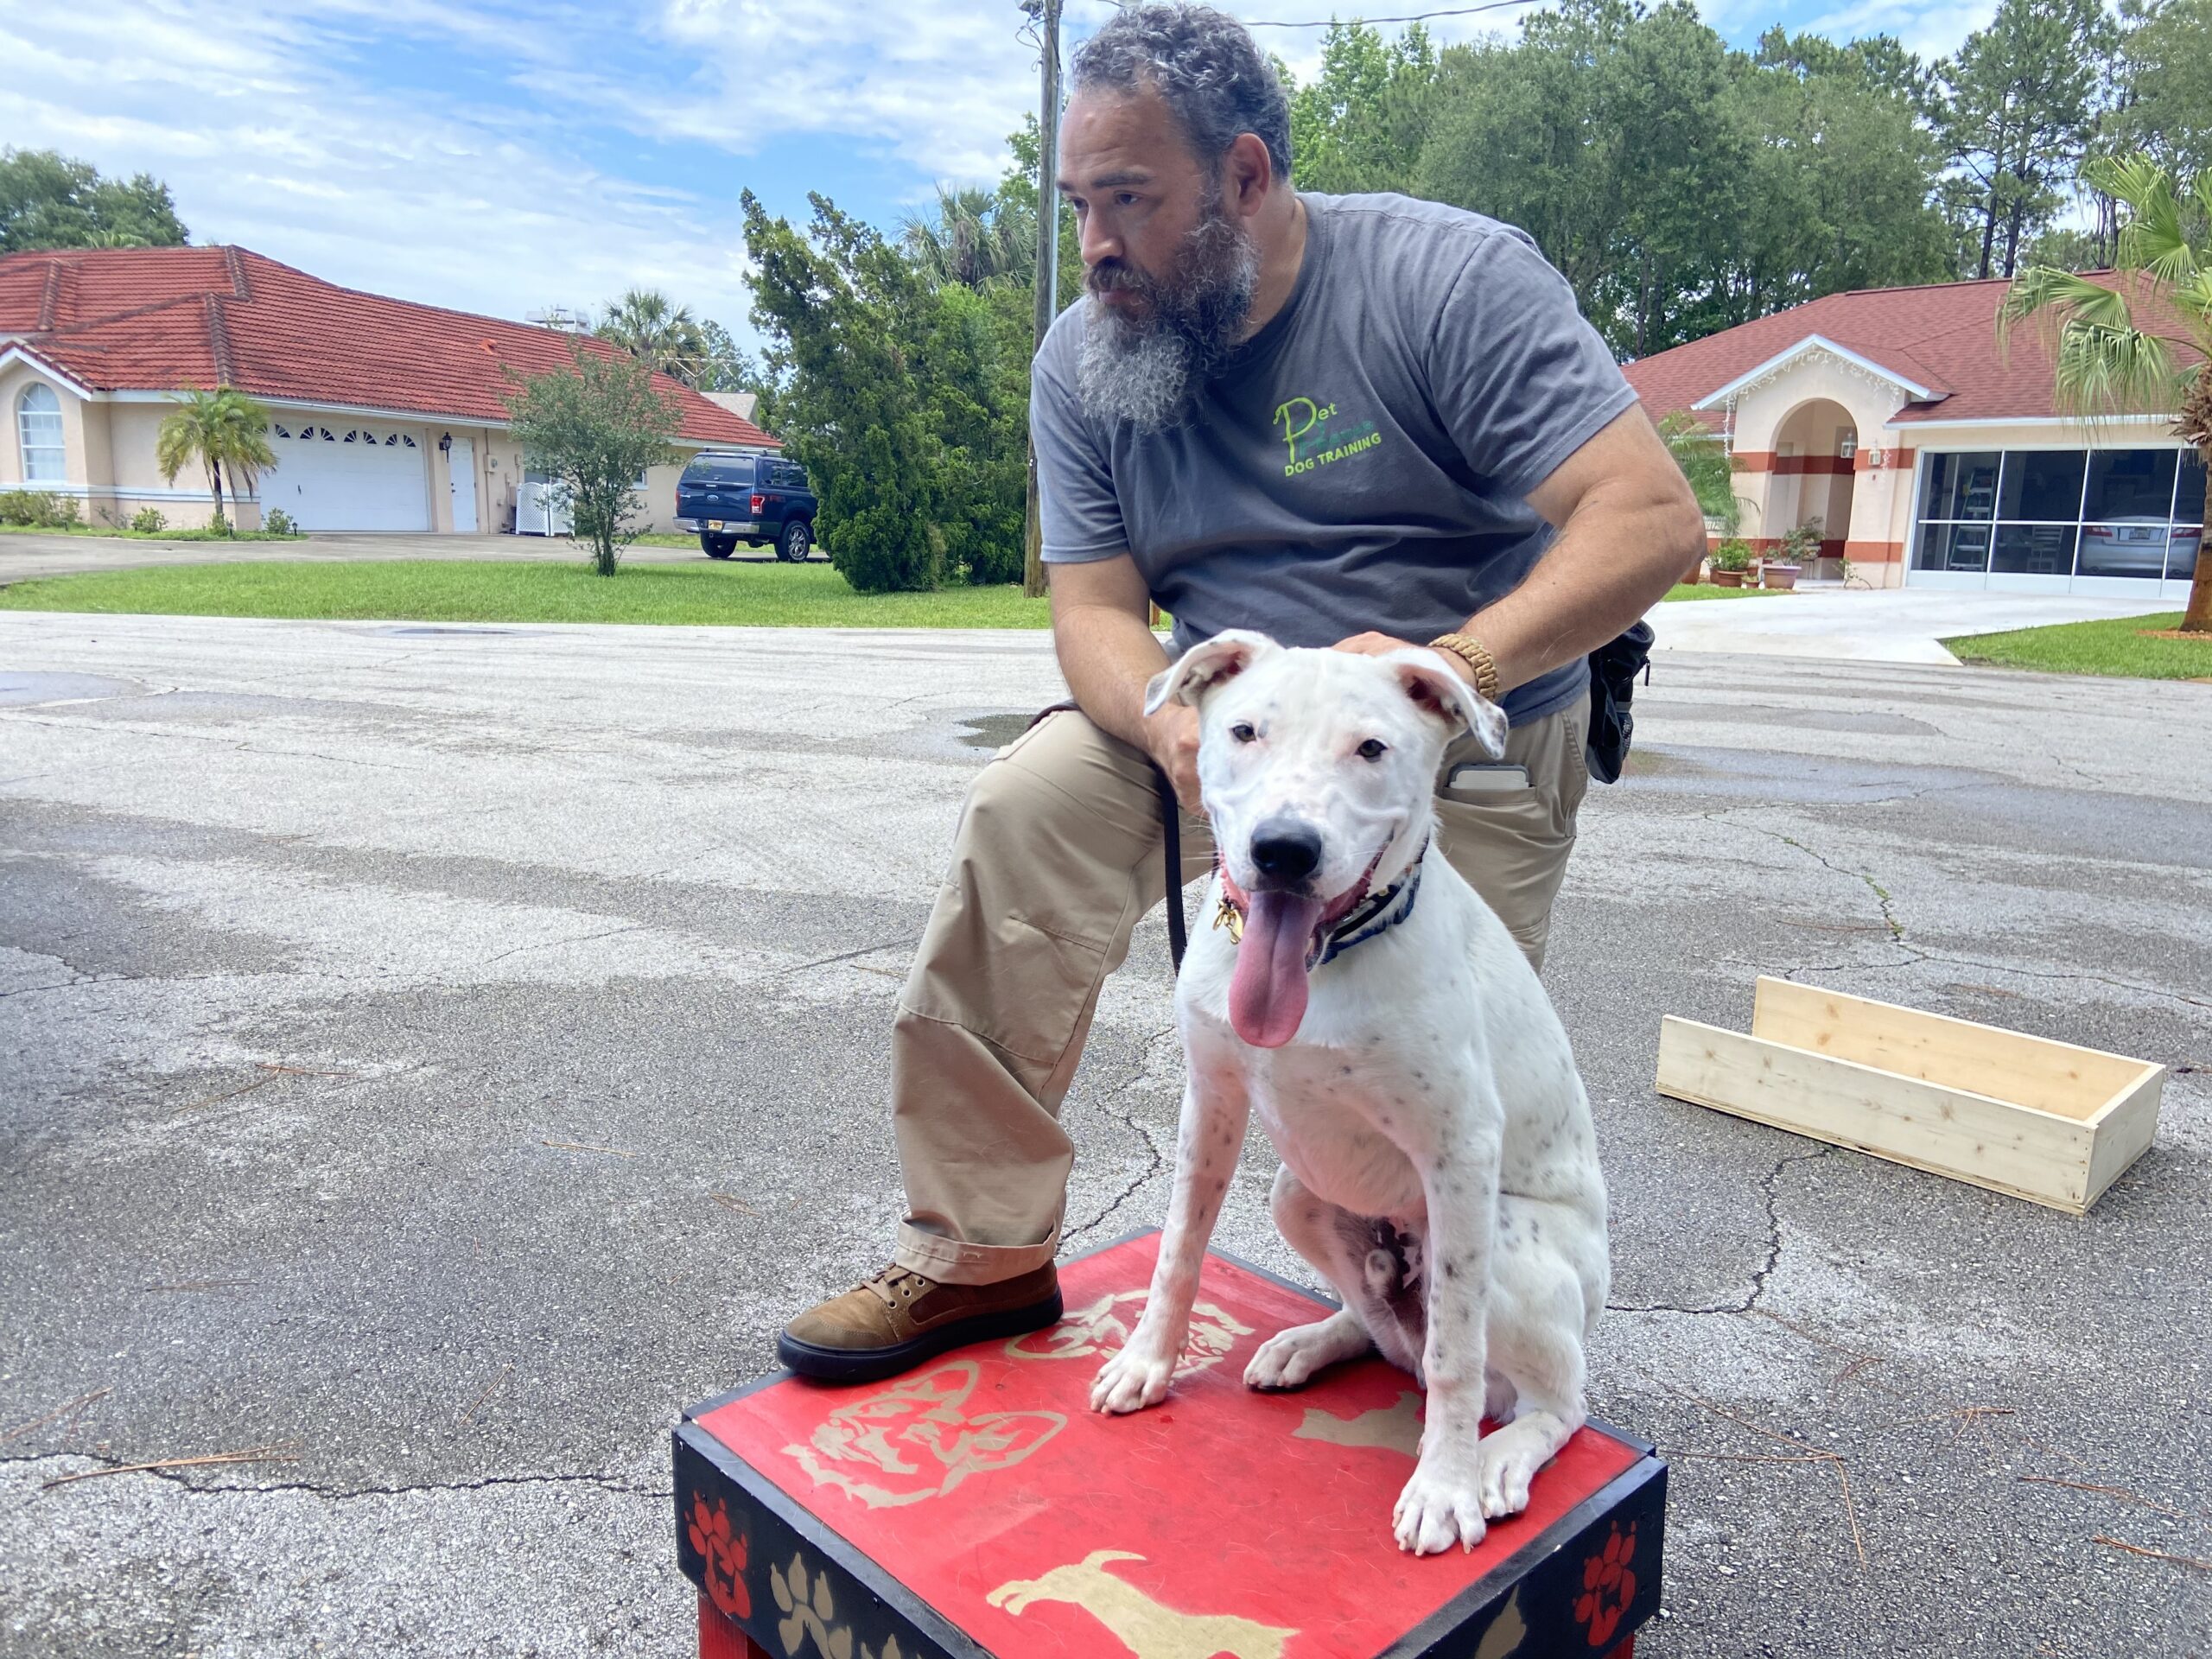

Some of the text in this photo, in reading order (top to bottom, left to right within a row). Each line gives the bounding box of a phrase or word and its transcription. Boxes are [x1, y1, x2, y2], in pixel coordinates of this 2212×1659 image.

[1273, 397, 1338, 464] Pet
[1285, 458, 1315, 477] DOG
[1317, 432, 1382, 466] TRAINING
